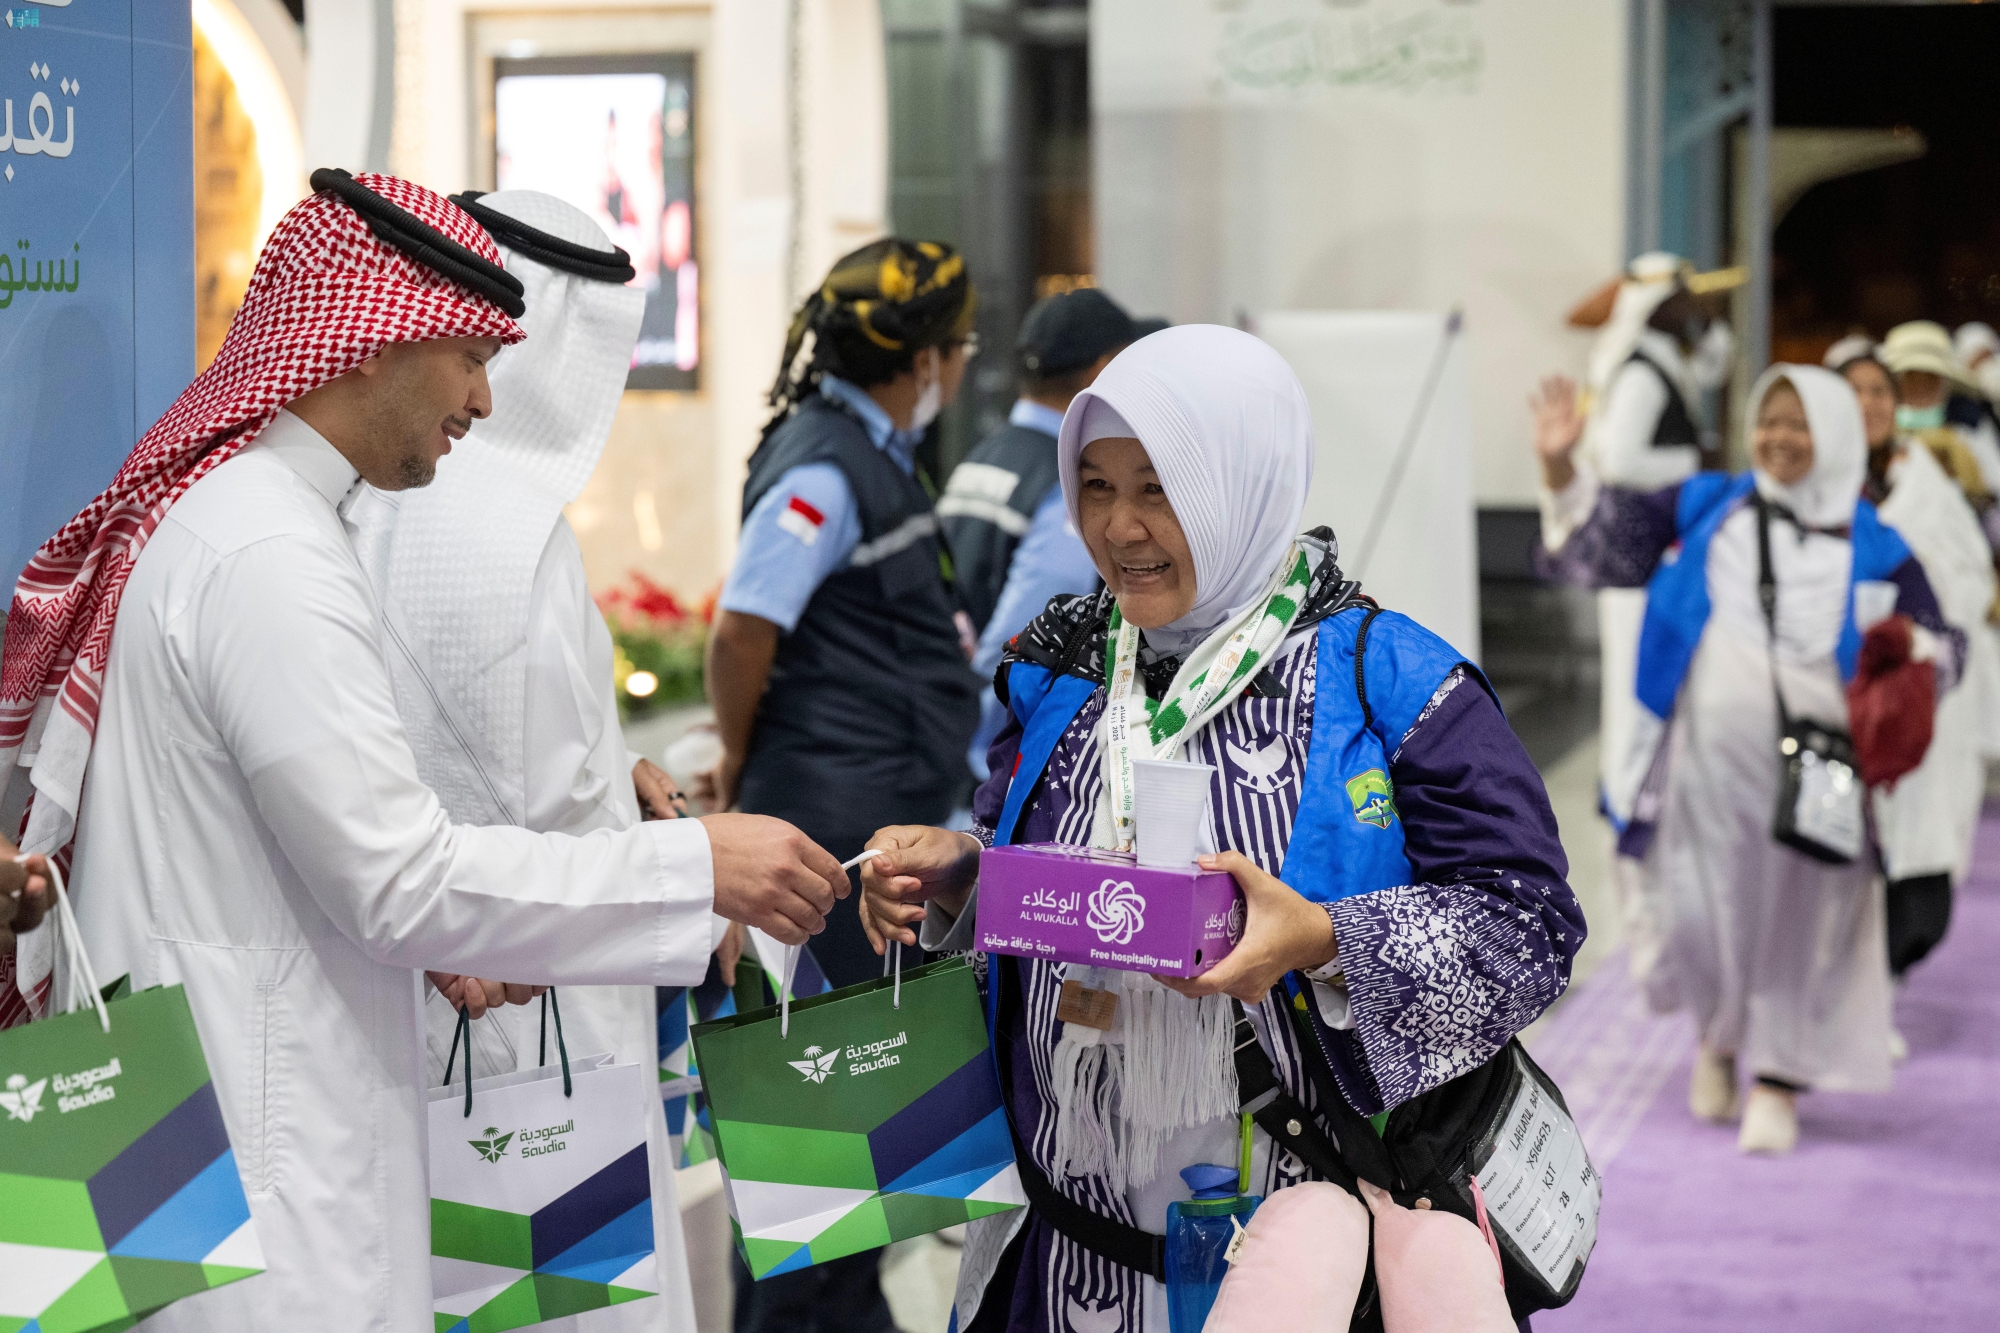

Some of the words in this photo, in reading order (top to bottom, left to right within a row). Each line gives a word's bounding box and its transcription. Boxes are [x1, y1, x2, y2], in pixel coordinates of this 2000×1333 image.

[1123, 795, 1133, 811] وزارة
[1021, 888, 1081, 914] الوكلاء
[1019, 911, 1031, 921] AL
[1033, 912, 1079, 926] WUKALLA
[1204, 912, 1227, 931] الوكلاء
[983, 932, 1008, 949] مجانية
[1010, 936, 1033, 952] ضيافة
[1036, 940, 1056, 955] وجبة
[1090, 948, 1110, 960] Free
[1111, 950, 1159, 968] hospitality
[1159, 958, 1183, 969] meal
[845, 1031, 908, 1061] السعودية
[849, 1053, 901, 1076] Saudia
[52, 1057, 122, 1096] السعودية
[57, 1084, 116, 1113] Saudia
[519, 1119, 575, 1145] السعودية
[521, 1139, 566, 1159] Saudia
[1481, 1171, 1498, 1192] Nama
[1497, 1199, 1509, 1212] No.
[1507, 1176, 1524, 1200] Paspor
[1515, 1196, 1542, 1233] Embarkasi
[1532, 1242, 1543, 1254] No.
[1559, 1190, 1570, 1209] 28
[1548, 1235, 1575, 1274] Rombongan
[1575, 1212, 1585, 1230] 3
